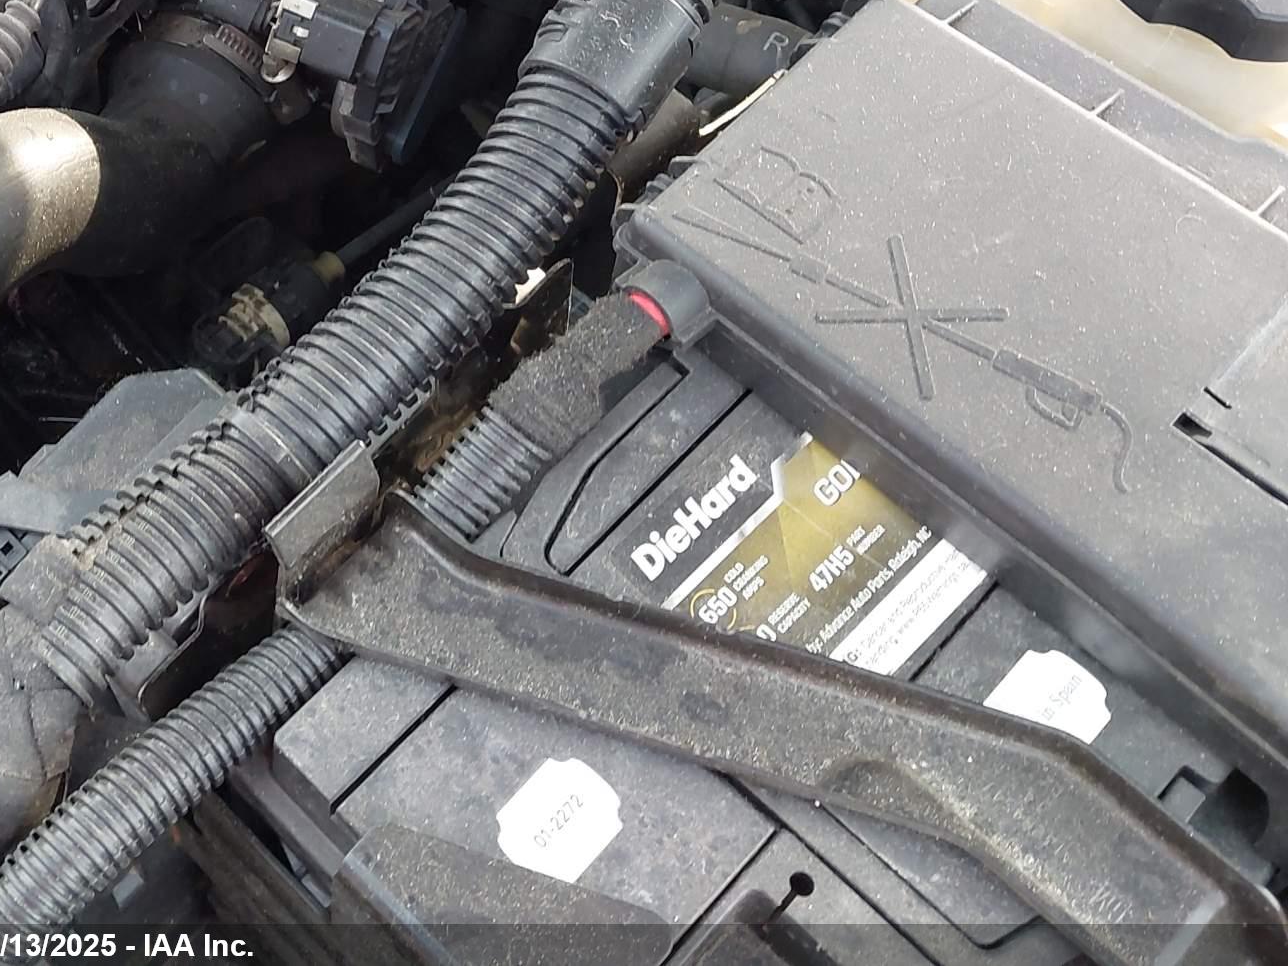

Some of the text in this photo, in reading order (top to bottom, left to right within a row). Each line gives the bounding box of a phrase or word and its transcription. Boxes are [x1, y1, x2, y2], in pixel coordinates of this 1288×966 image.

[630, 455, 759, 581] DieHard
[698, 588, 738, 625] 650
[723, 562, 744, 583] COLD
[742, 576, 765, 601] AMPS
[809, 525, 886, 594] 47H5 PART NUMBER
[818, 604, 855, 643] Advance
[848, 585, 873, 612] Auto
[866, 565, 895, 594] Parts,
[915, 524, 934, 544] NC
[776, 599, 812, 634] CAPACITY
